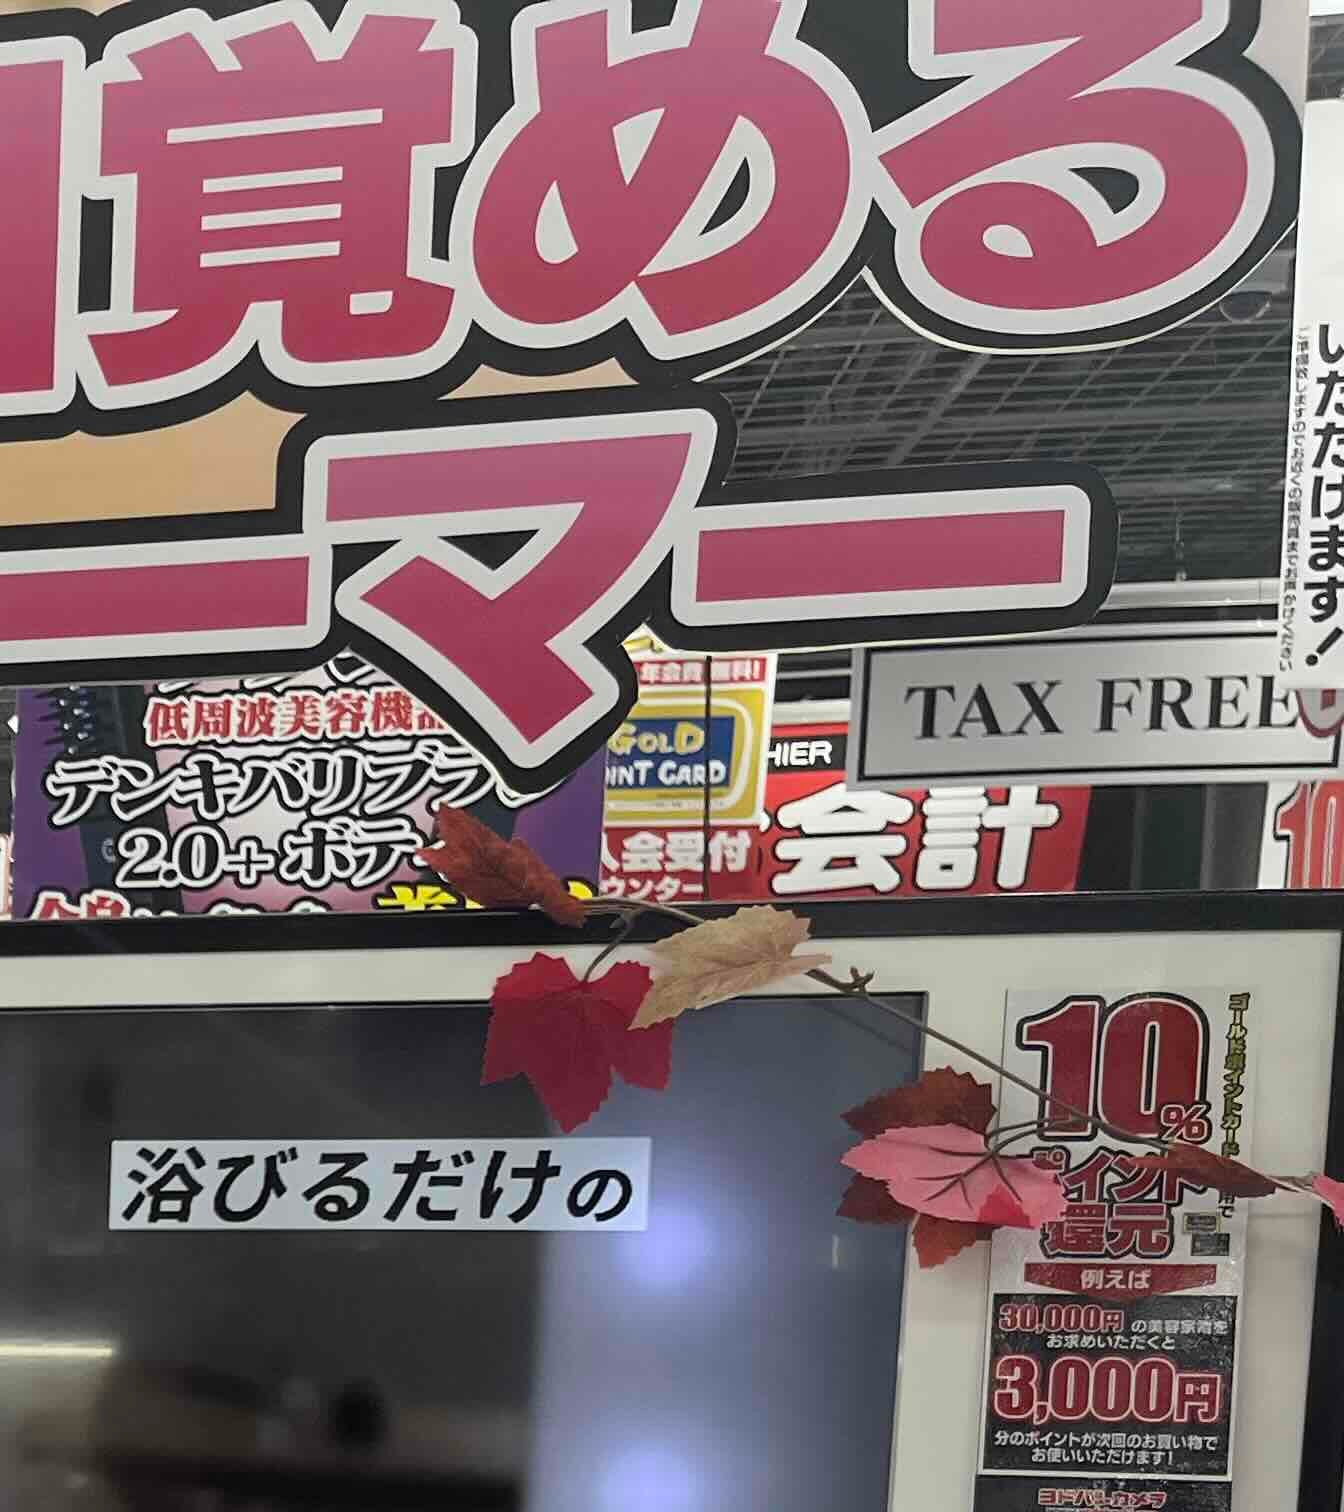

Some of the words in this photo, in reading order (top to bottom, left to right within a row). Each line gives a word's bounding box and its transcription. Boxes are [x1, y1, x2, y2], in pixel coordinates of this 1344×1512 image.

[906, 680, 1064, 741] TAX
[1095, 674, 1300, 735] FREE
[46, 740, 502, 826] デンキバリブラ
[770, 784, 1063, 895] 会計
[123, 1147, 632, 1223] 浴びるだけの
[1033, 1145, 1204, 1205] イント
[1039, 1200, 1174, 1261] 還元
[1080, 1268, 1152, 1291] 例えば
[1047, 1333, 1177, 1352] お求めいただくと
[993, 1355, 1221, 1424] 3,000円
[994, 1431, 1218, 1453] 分のポイントが次回のお買い物で
[1031, 1447, 1174, 1467] お使いいただけます!
[1037, 1488, 1167, 1509] ヨドバシカメラ
